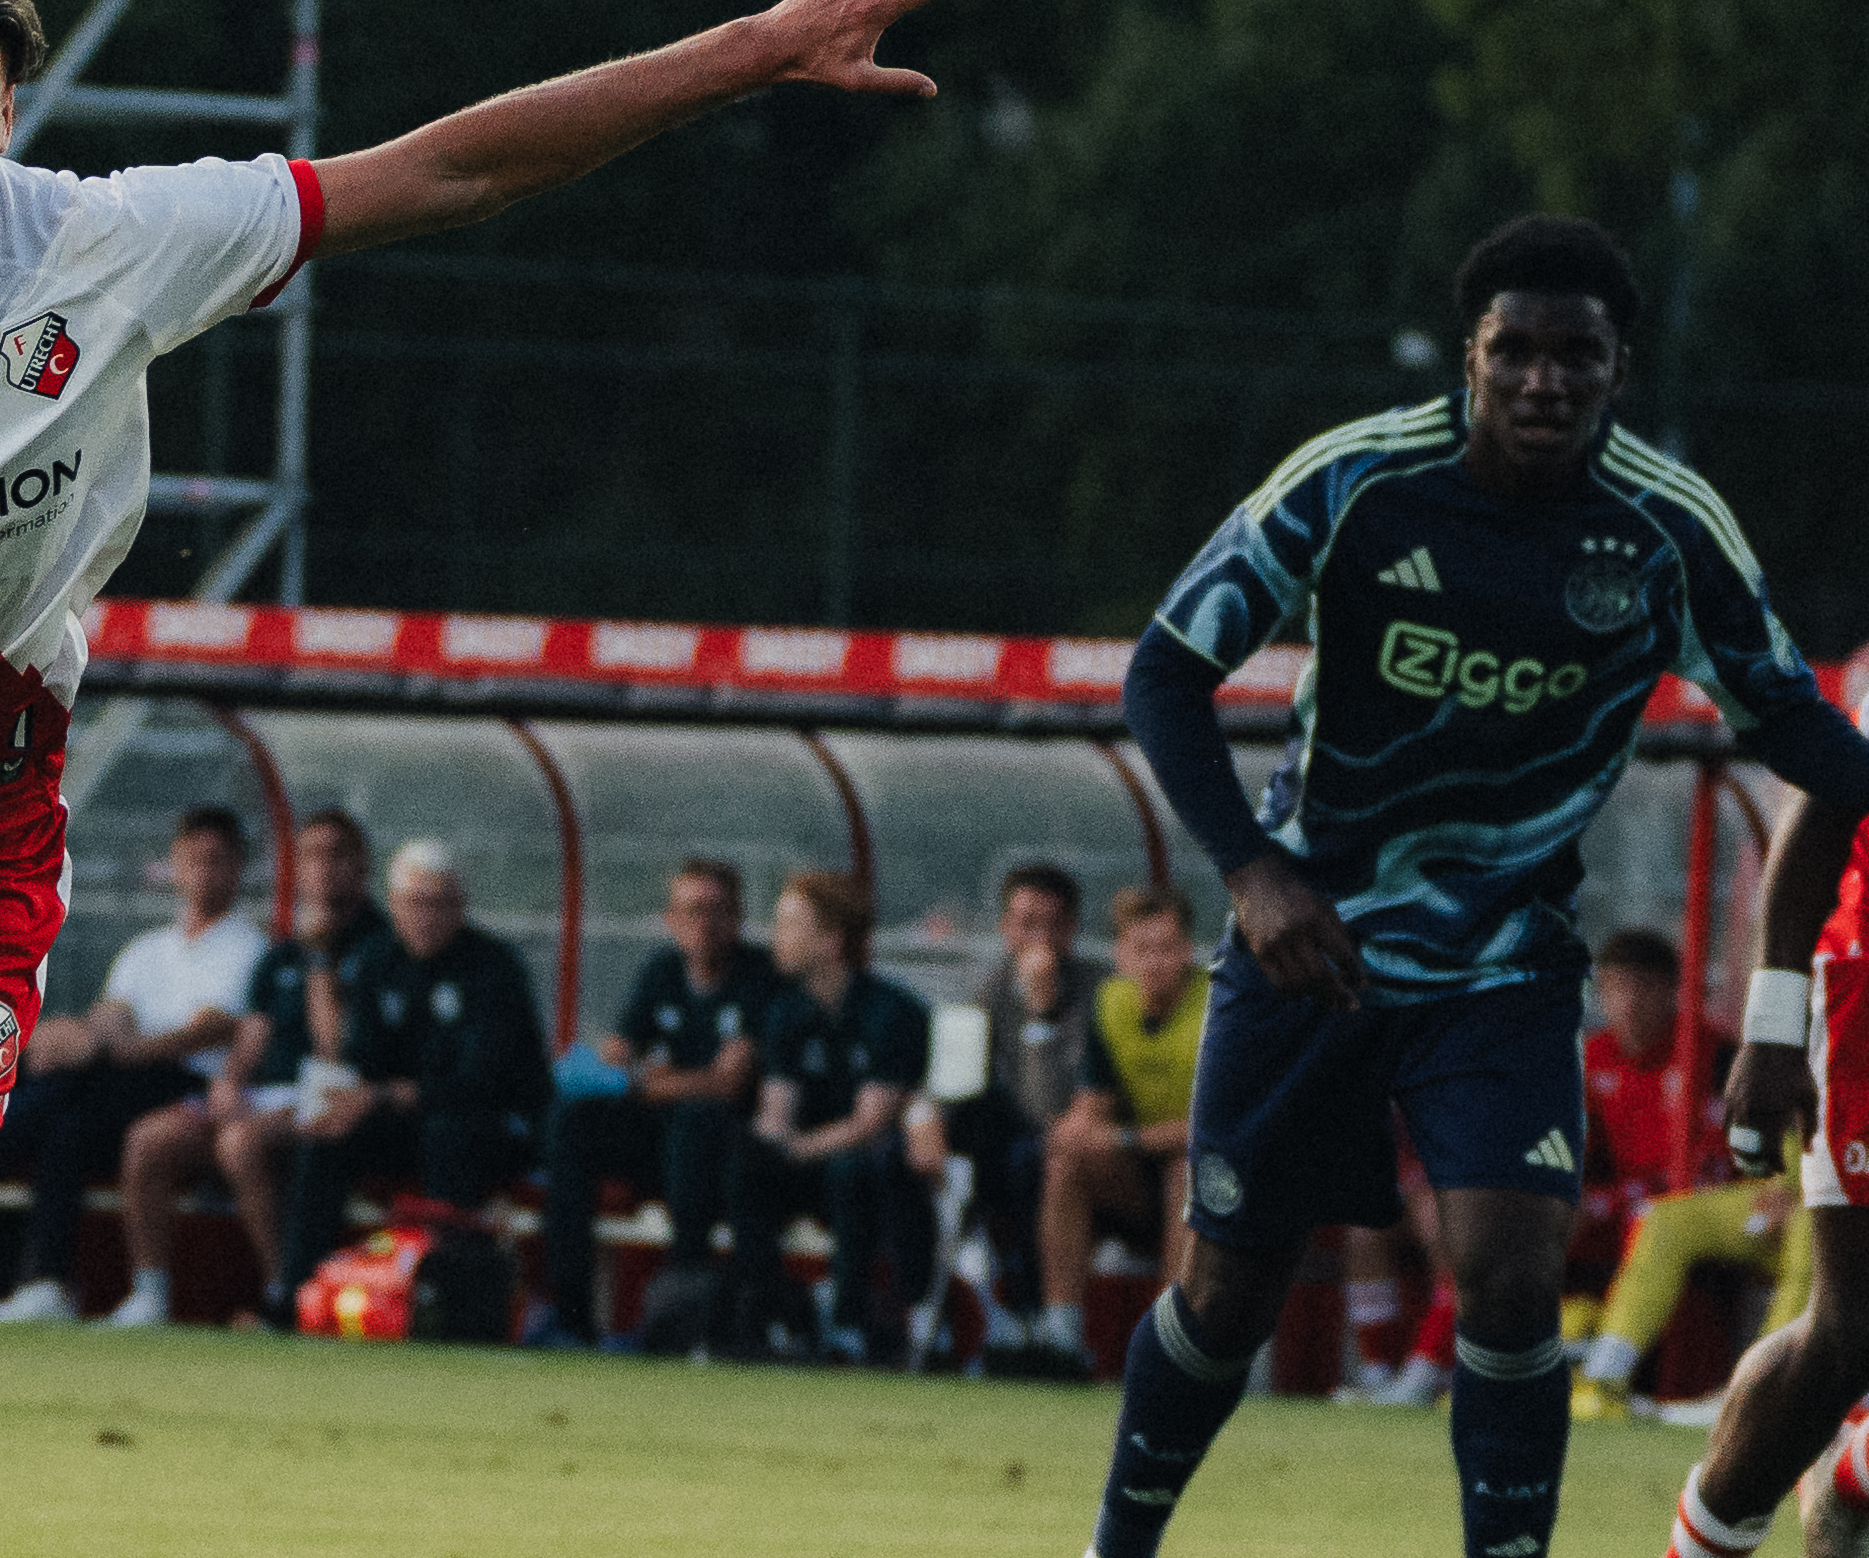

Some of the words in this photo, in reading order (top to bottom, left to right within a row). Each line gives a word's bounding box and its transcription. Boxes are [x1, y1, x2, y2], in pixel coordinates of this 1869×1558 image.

[13, 334, 27, 356] F
[20, 316, 62, 390] UTRECHT
[49, 353, 69, 375] C
